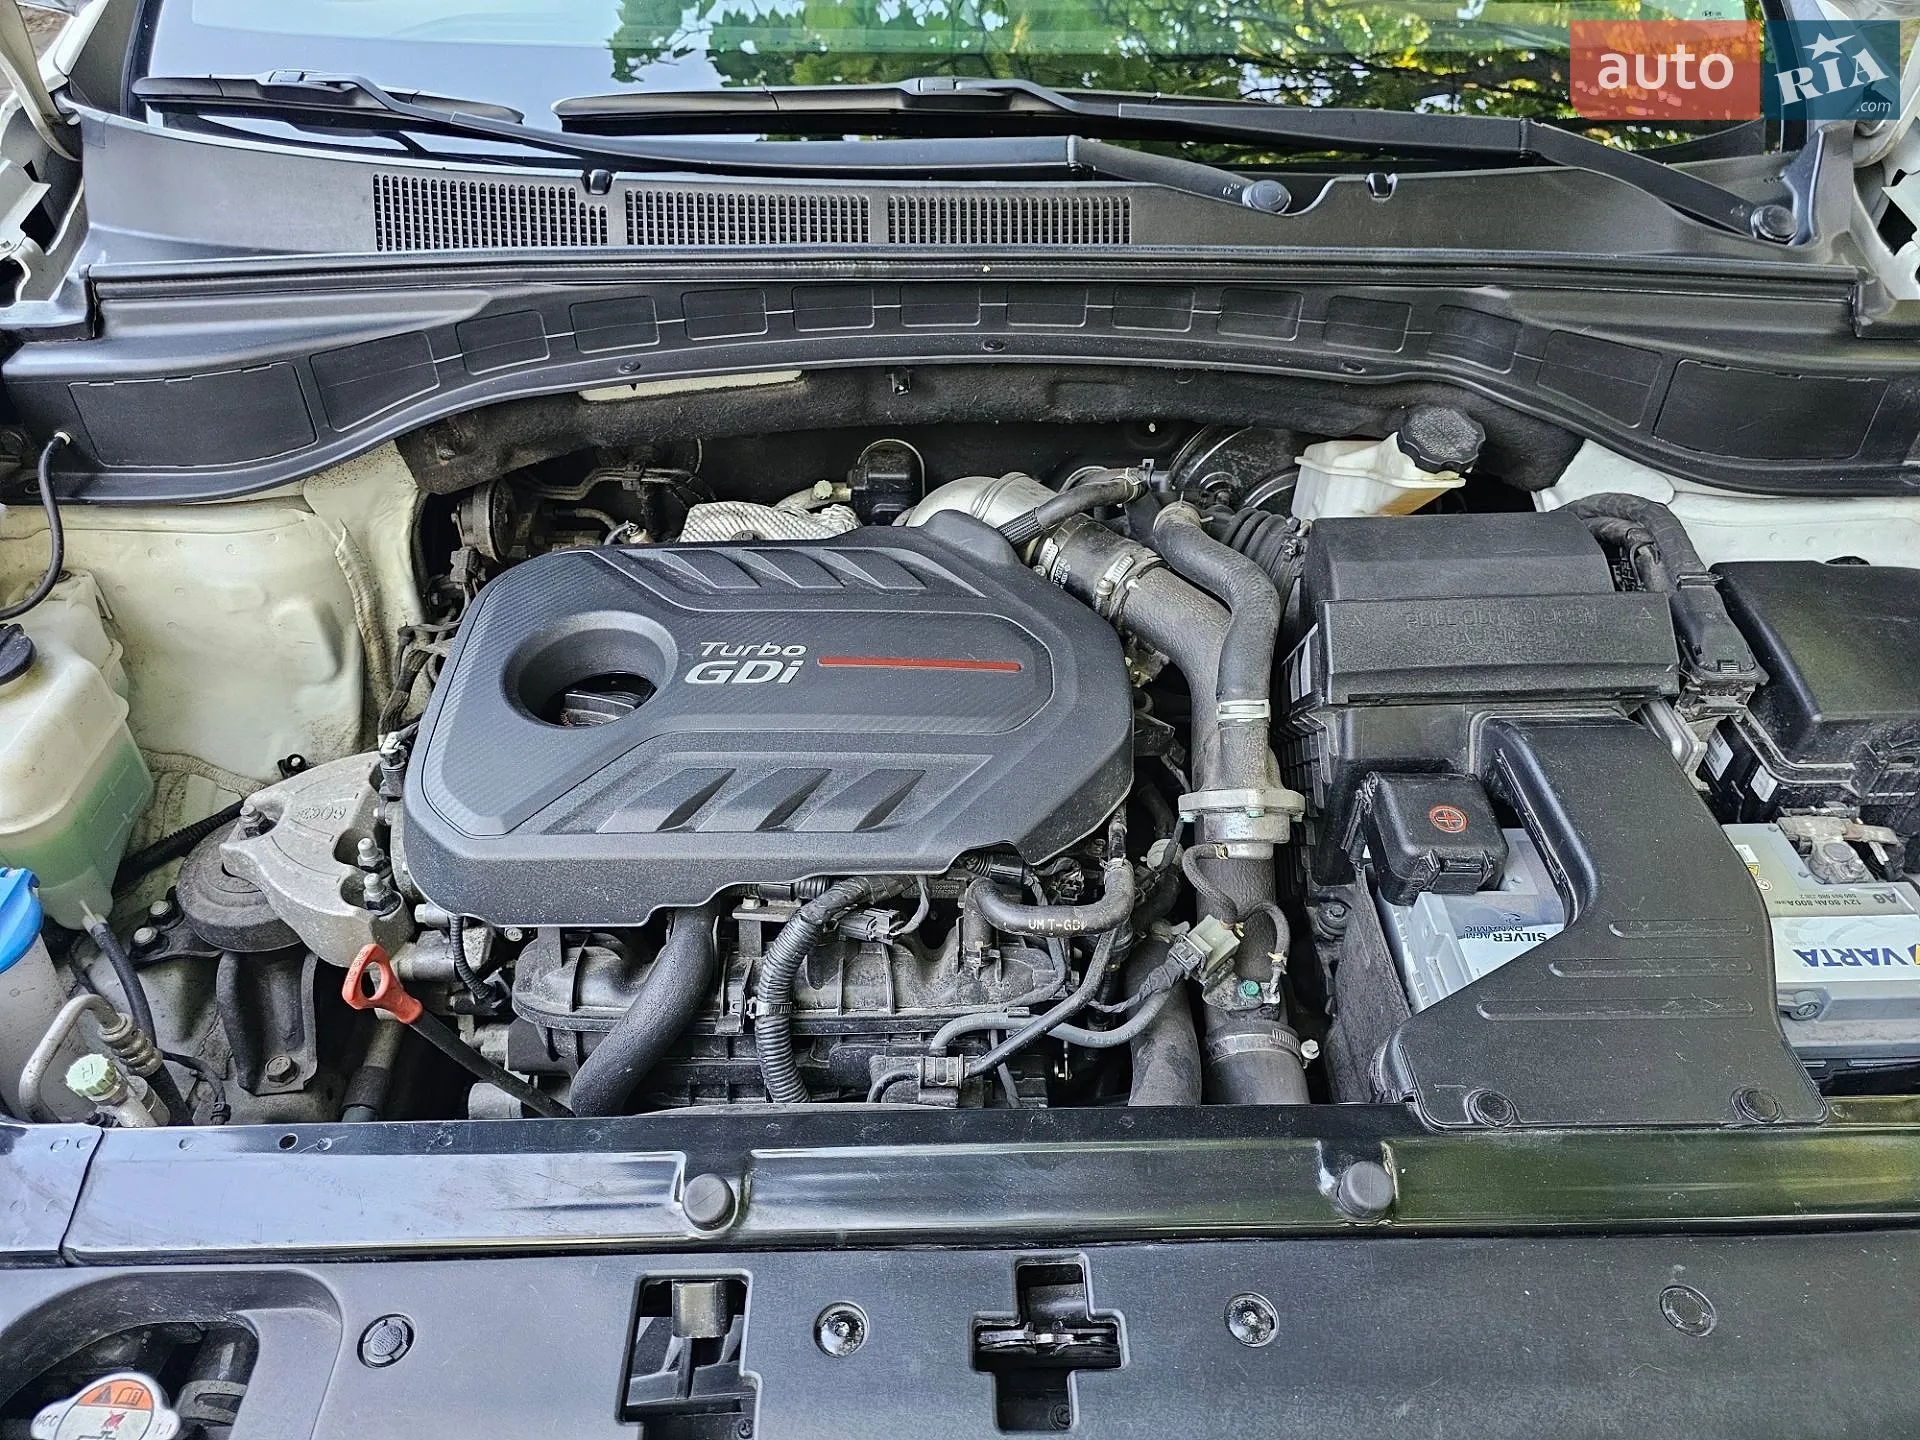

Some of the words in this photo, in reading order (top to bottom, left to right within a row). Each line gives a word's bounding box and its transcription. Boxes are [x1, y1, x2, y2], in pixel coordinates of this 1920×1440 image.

[700, 641, 807, 657] Turbo
[684, 660, 806, 684] GDi
[1873, 892, 1898, 905] A6
[1028, 919, 1044, 930] UM
[1493, 932, 1547, 942] SILVER
[1792, 947, 1909, 968] VARTA
